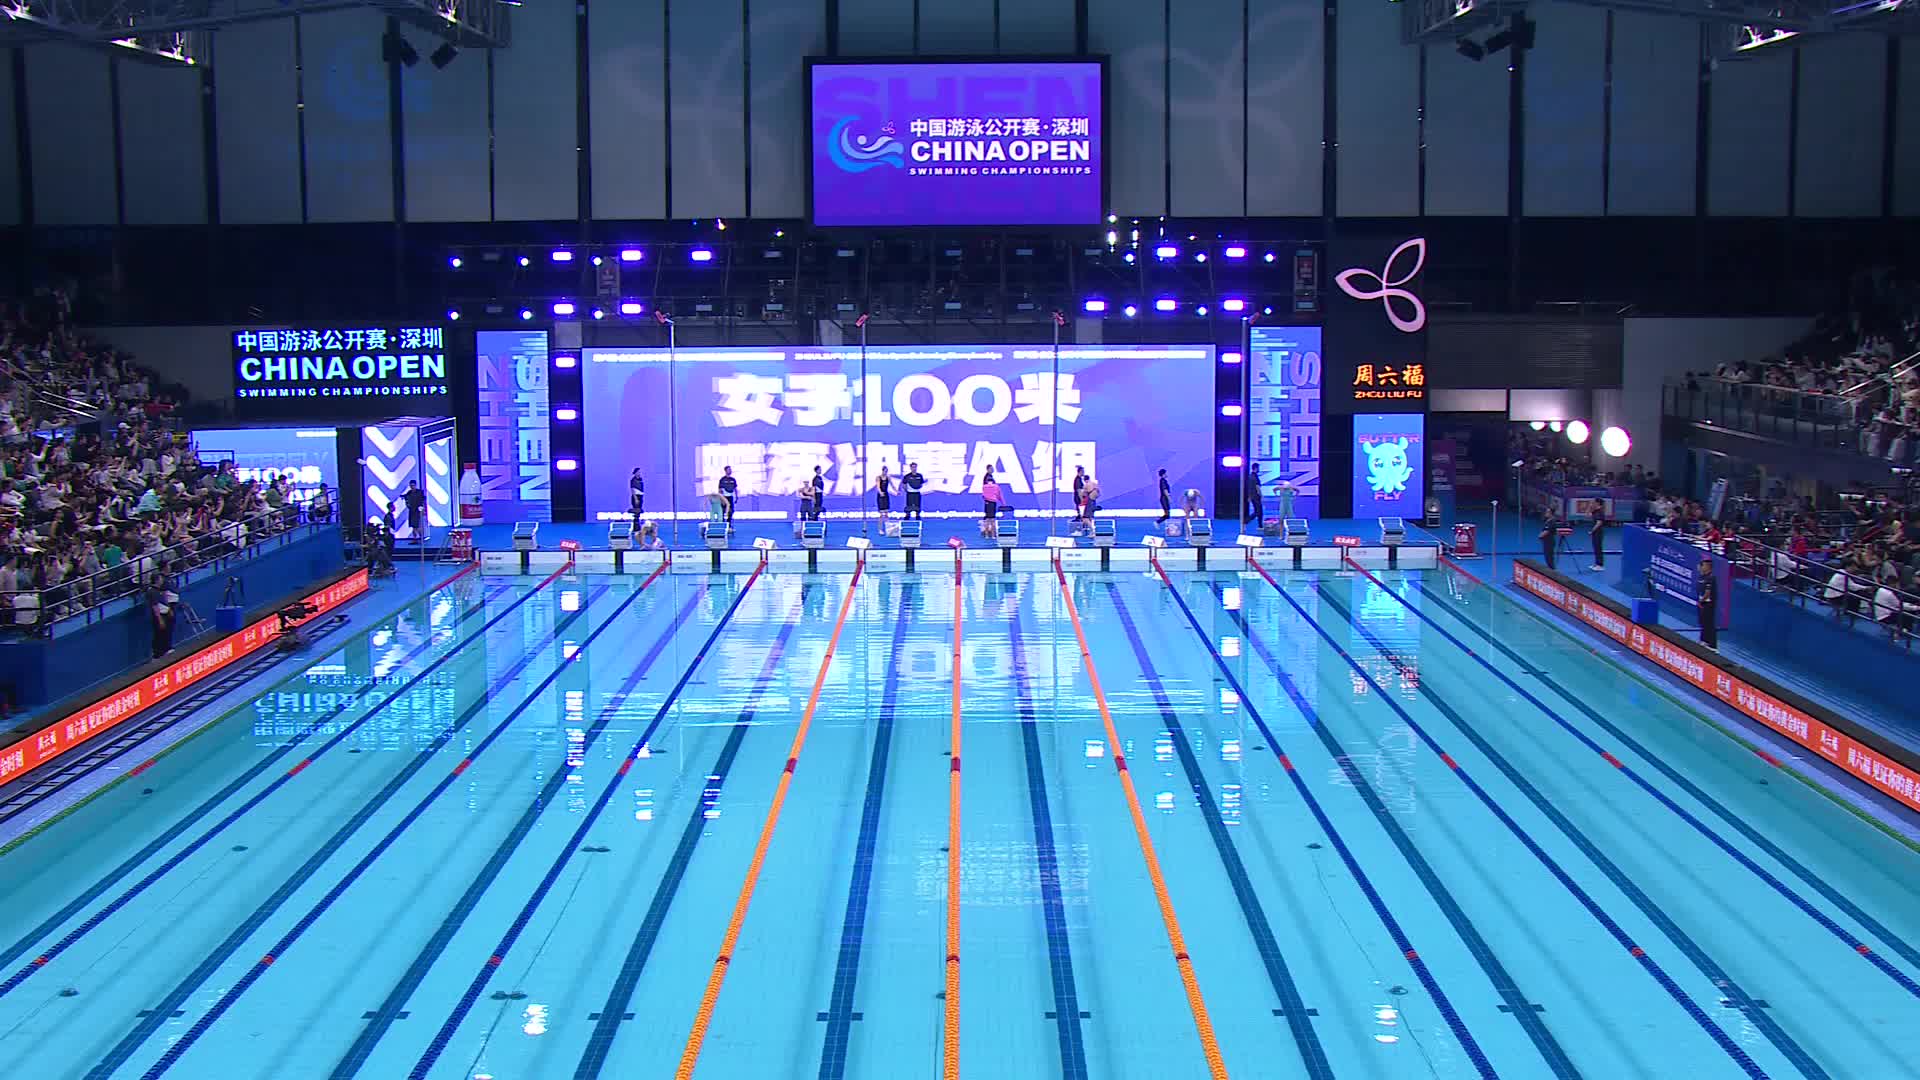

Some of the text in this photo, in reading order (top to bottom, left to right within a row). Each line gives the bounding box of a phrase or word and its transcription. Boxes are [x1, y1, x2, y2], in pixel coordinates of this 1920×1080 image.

[910, 118, 1089, 137] 中国游泳公开赛·深圳
[911, 140, 1090, 162] CHINA OPEN
[909, 166, 1091, 176] SWIMMING CHAMPIONSHIPS
[237, 328, 443, 353] 中国游泳公开赛·深圳
[240, 355, 445, 381] CHINA OPEN
[1353, 364, 1424, 386] 周六福
[239, 386, 448, 398] SWIMMING CHAMPIONSHIPS
[712, 373, 1083, 427] 女子100米
[1289, 352, 1320, 496] SHEN
